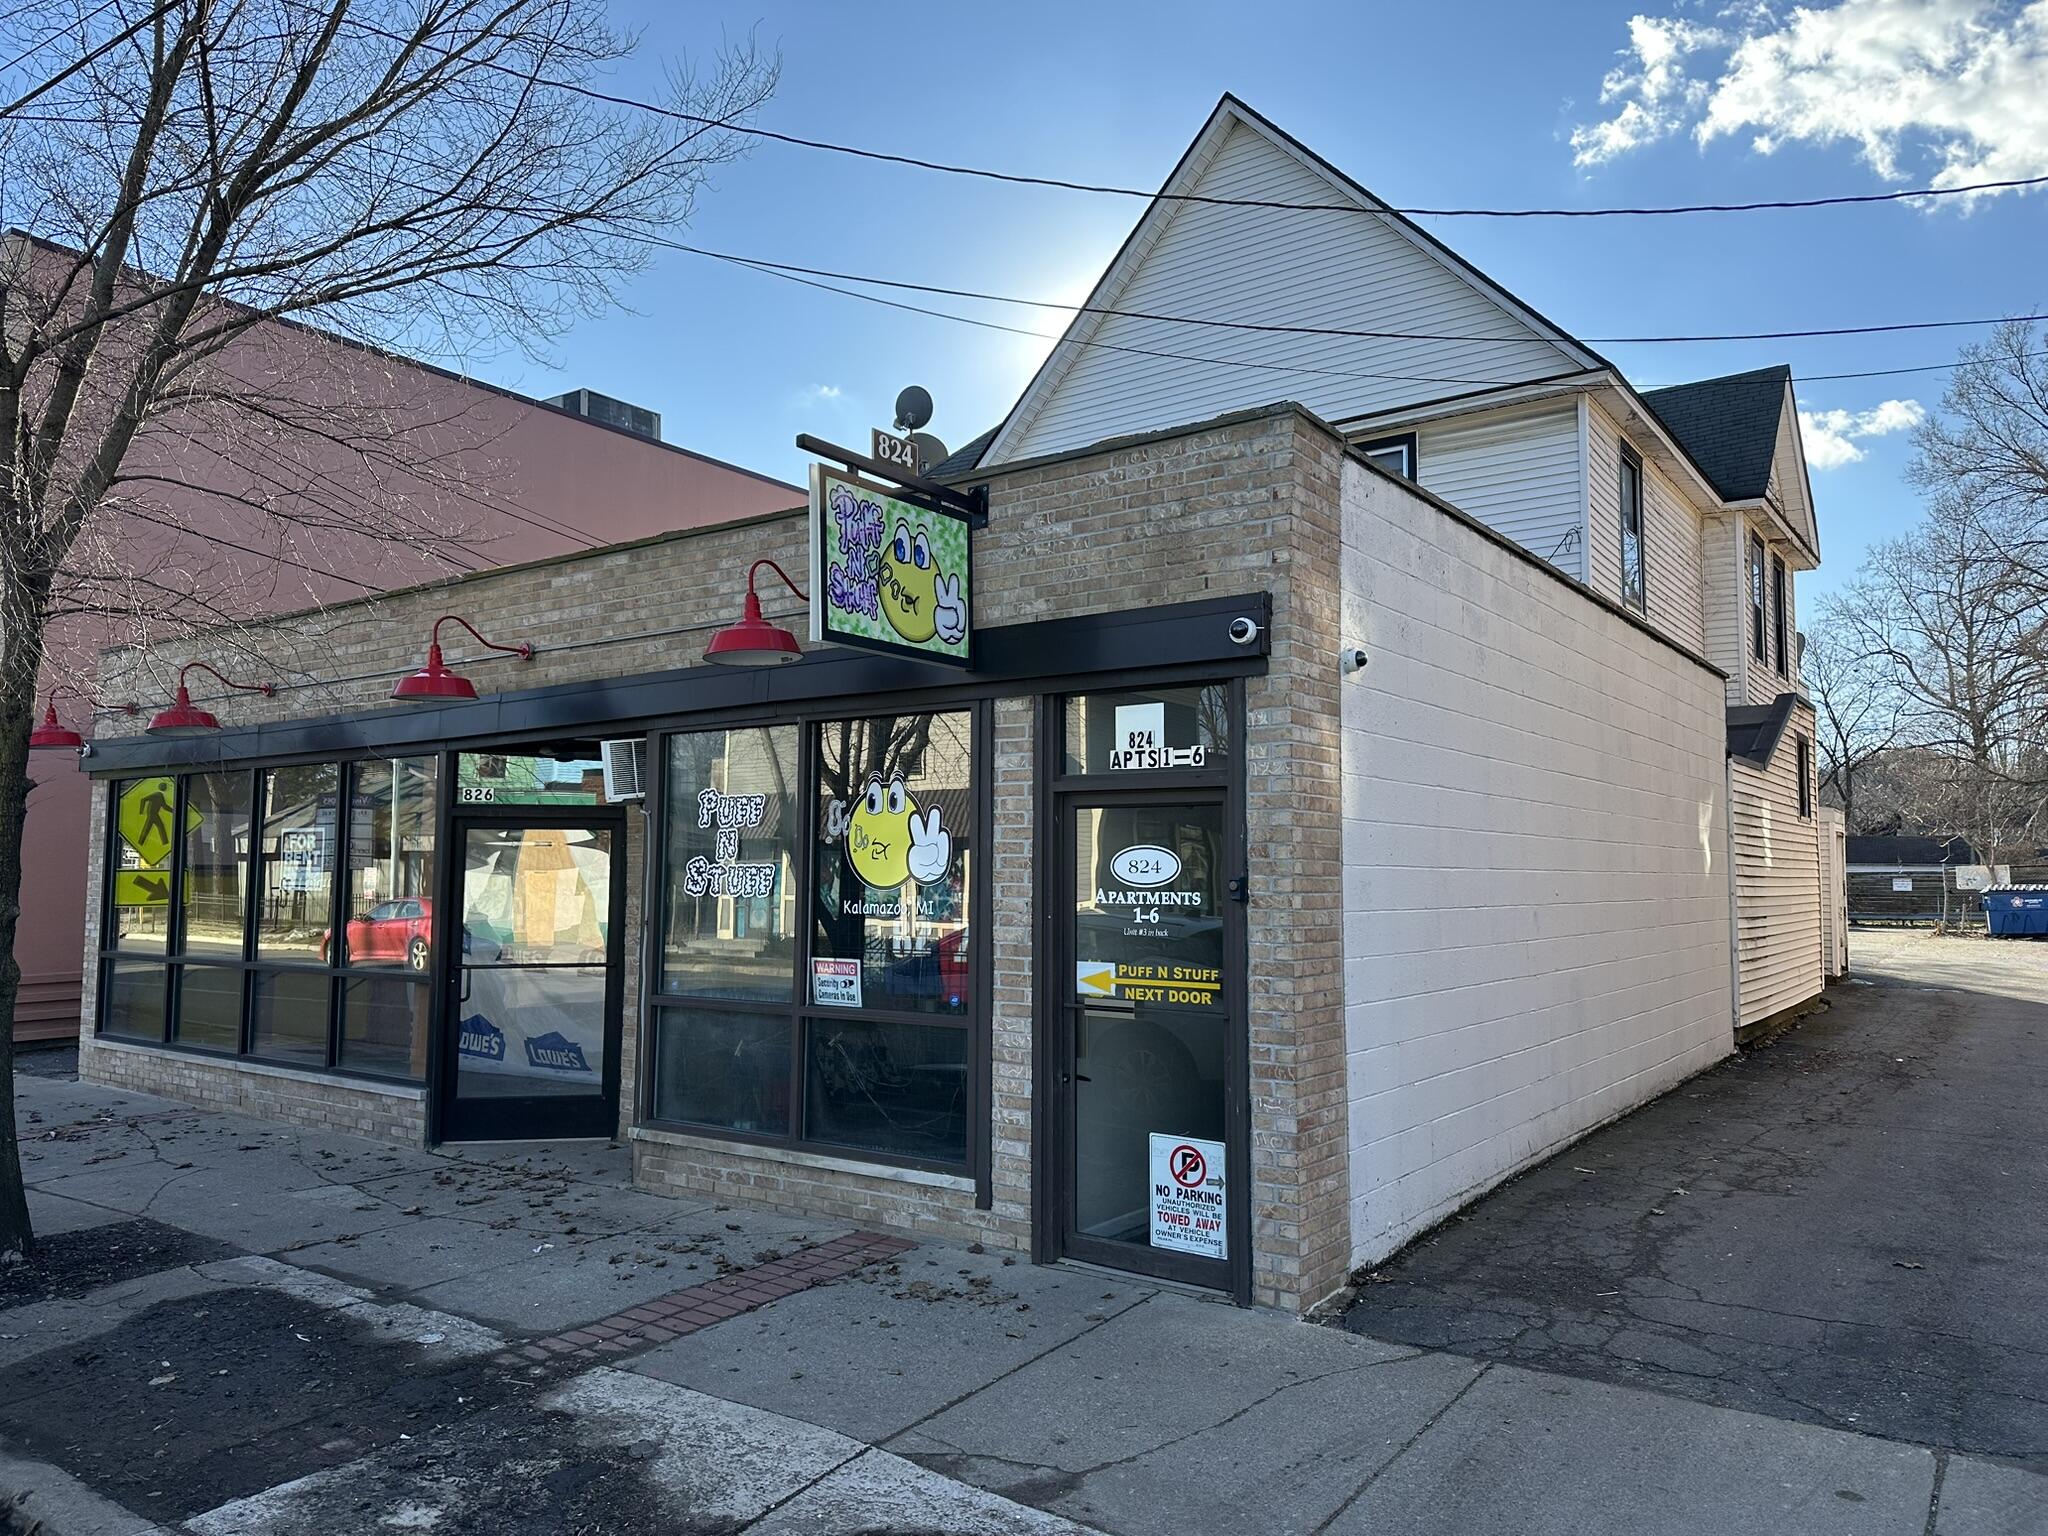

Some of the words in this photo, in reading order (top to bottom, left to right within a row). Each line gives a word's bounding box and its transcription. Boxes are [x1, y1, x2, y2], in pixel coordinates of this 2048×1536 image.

[878, 434, 914, 468] 824
[847, 545, 866, 580] N
[1128, 730, 1153, 749] 824
[1110, 749, 1158, 769] APTS
[464, 788, 493, 801] 826
[289, 834, 316, 850] FOR
[716, 828, 738, 862] N
[284, 850, 321, 865] RENT
[1127, 859, 1162, 874] 824
[915, 900, 934, 915] MI
[1133, 906, 1160, 925] 1-6
[1123, 927, 1137, 937] Unit
[1148, 929, 1155, 938] in
[1155, 928, 1169, 938] back
[815, 963, 856, 975] WARNING
[1119, 964, 1153, 978] PUFF
[1157, 966, 1168, 979] N
[1173, 967, 1219, 981] STUFF
[817, 977, 839, 991] Security
[818, 989, 840, 1000] Cameras
[845, 992, 856, 1002] Use
[1124, 987, 1164, 1001] NEXT
[1168, 989, 1212, 1005] DOOR
[459, 1033, 500, 1056] OWE'S
[1155, 1184, 1170, 1197] NO
[1176, 1187, 1223, 1206] PARKING
[1156, 1203, 1190, 1215] VEHICLES
[1193, 1209, 1209, 1218] WILL
[1212, 1212, 1222, 1220] BE
[1162, 1197, 1216, 1212] UNAUTHORIZED
[1157, 1211, 1190, 1227] TOWED
[1195, 1217, 1221, 1232] AWAY
[1155, 1229, 1188, 1241] OWNER'S
[1189, 1235, 1223, 1247] EXPENSE
[1179, 1226, 1210, 1238] VEHICLE
